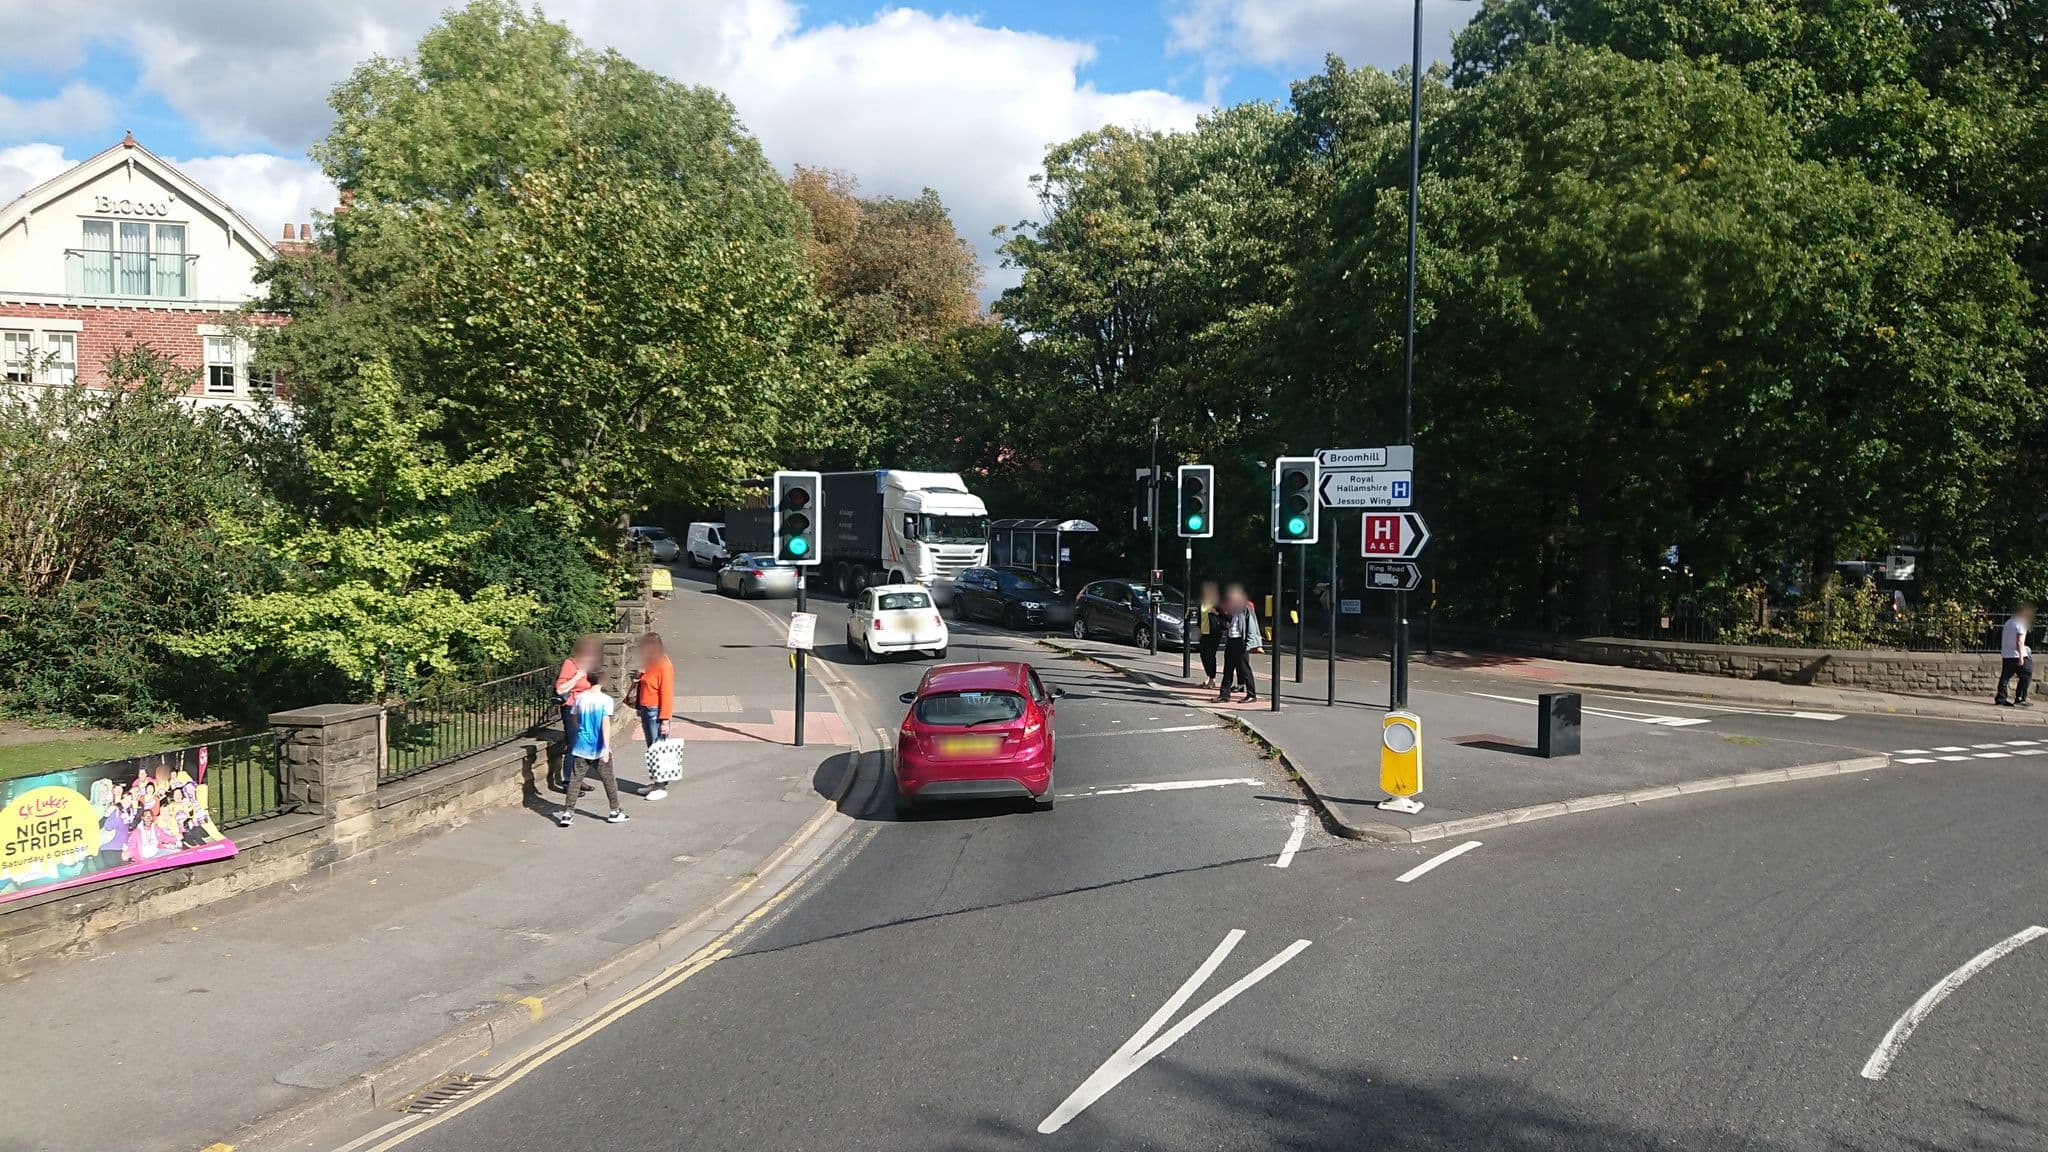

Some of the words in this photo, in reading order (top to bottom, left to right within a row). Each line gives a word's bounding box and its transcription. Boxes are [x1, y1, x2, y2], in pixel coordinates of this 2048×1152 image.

[1330, 452, 1380, 463] Broomhill
[1350, 475, 1374, 484] Royal
[1336, 484, 1388, 492] Hallamshire
[1394, 483, 1407, 497] H
[1336, 497, 1366, 506] Jessop
[1369, 497, 1392, 506] Wing
[1374, 519, 1391, 540] H
[1370, 542, 1376, 550] A
[1379, 542, 1386, 550] &
[1389, 542, 1395, 550] E
[1368, 564, 1385, 573] Ring
[1387, 565, 1405, 573] Road
[17, 816, 72, 839] NIGHT
[5, 828, 83, 856] STRIDER
[1, 855, 44, 869] Saturday
[53, 845, 88, 858] October
